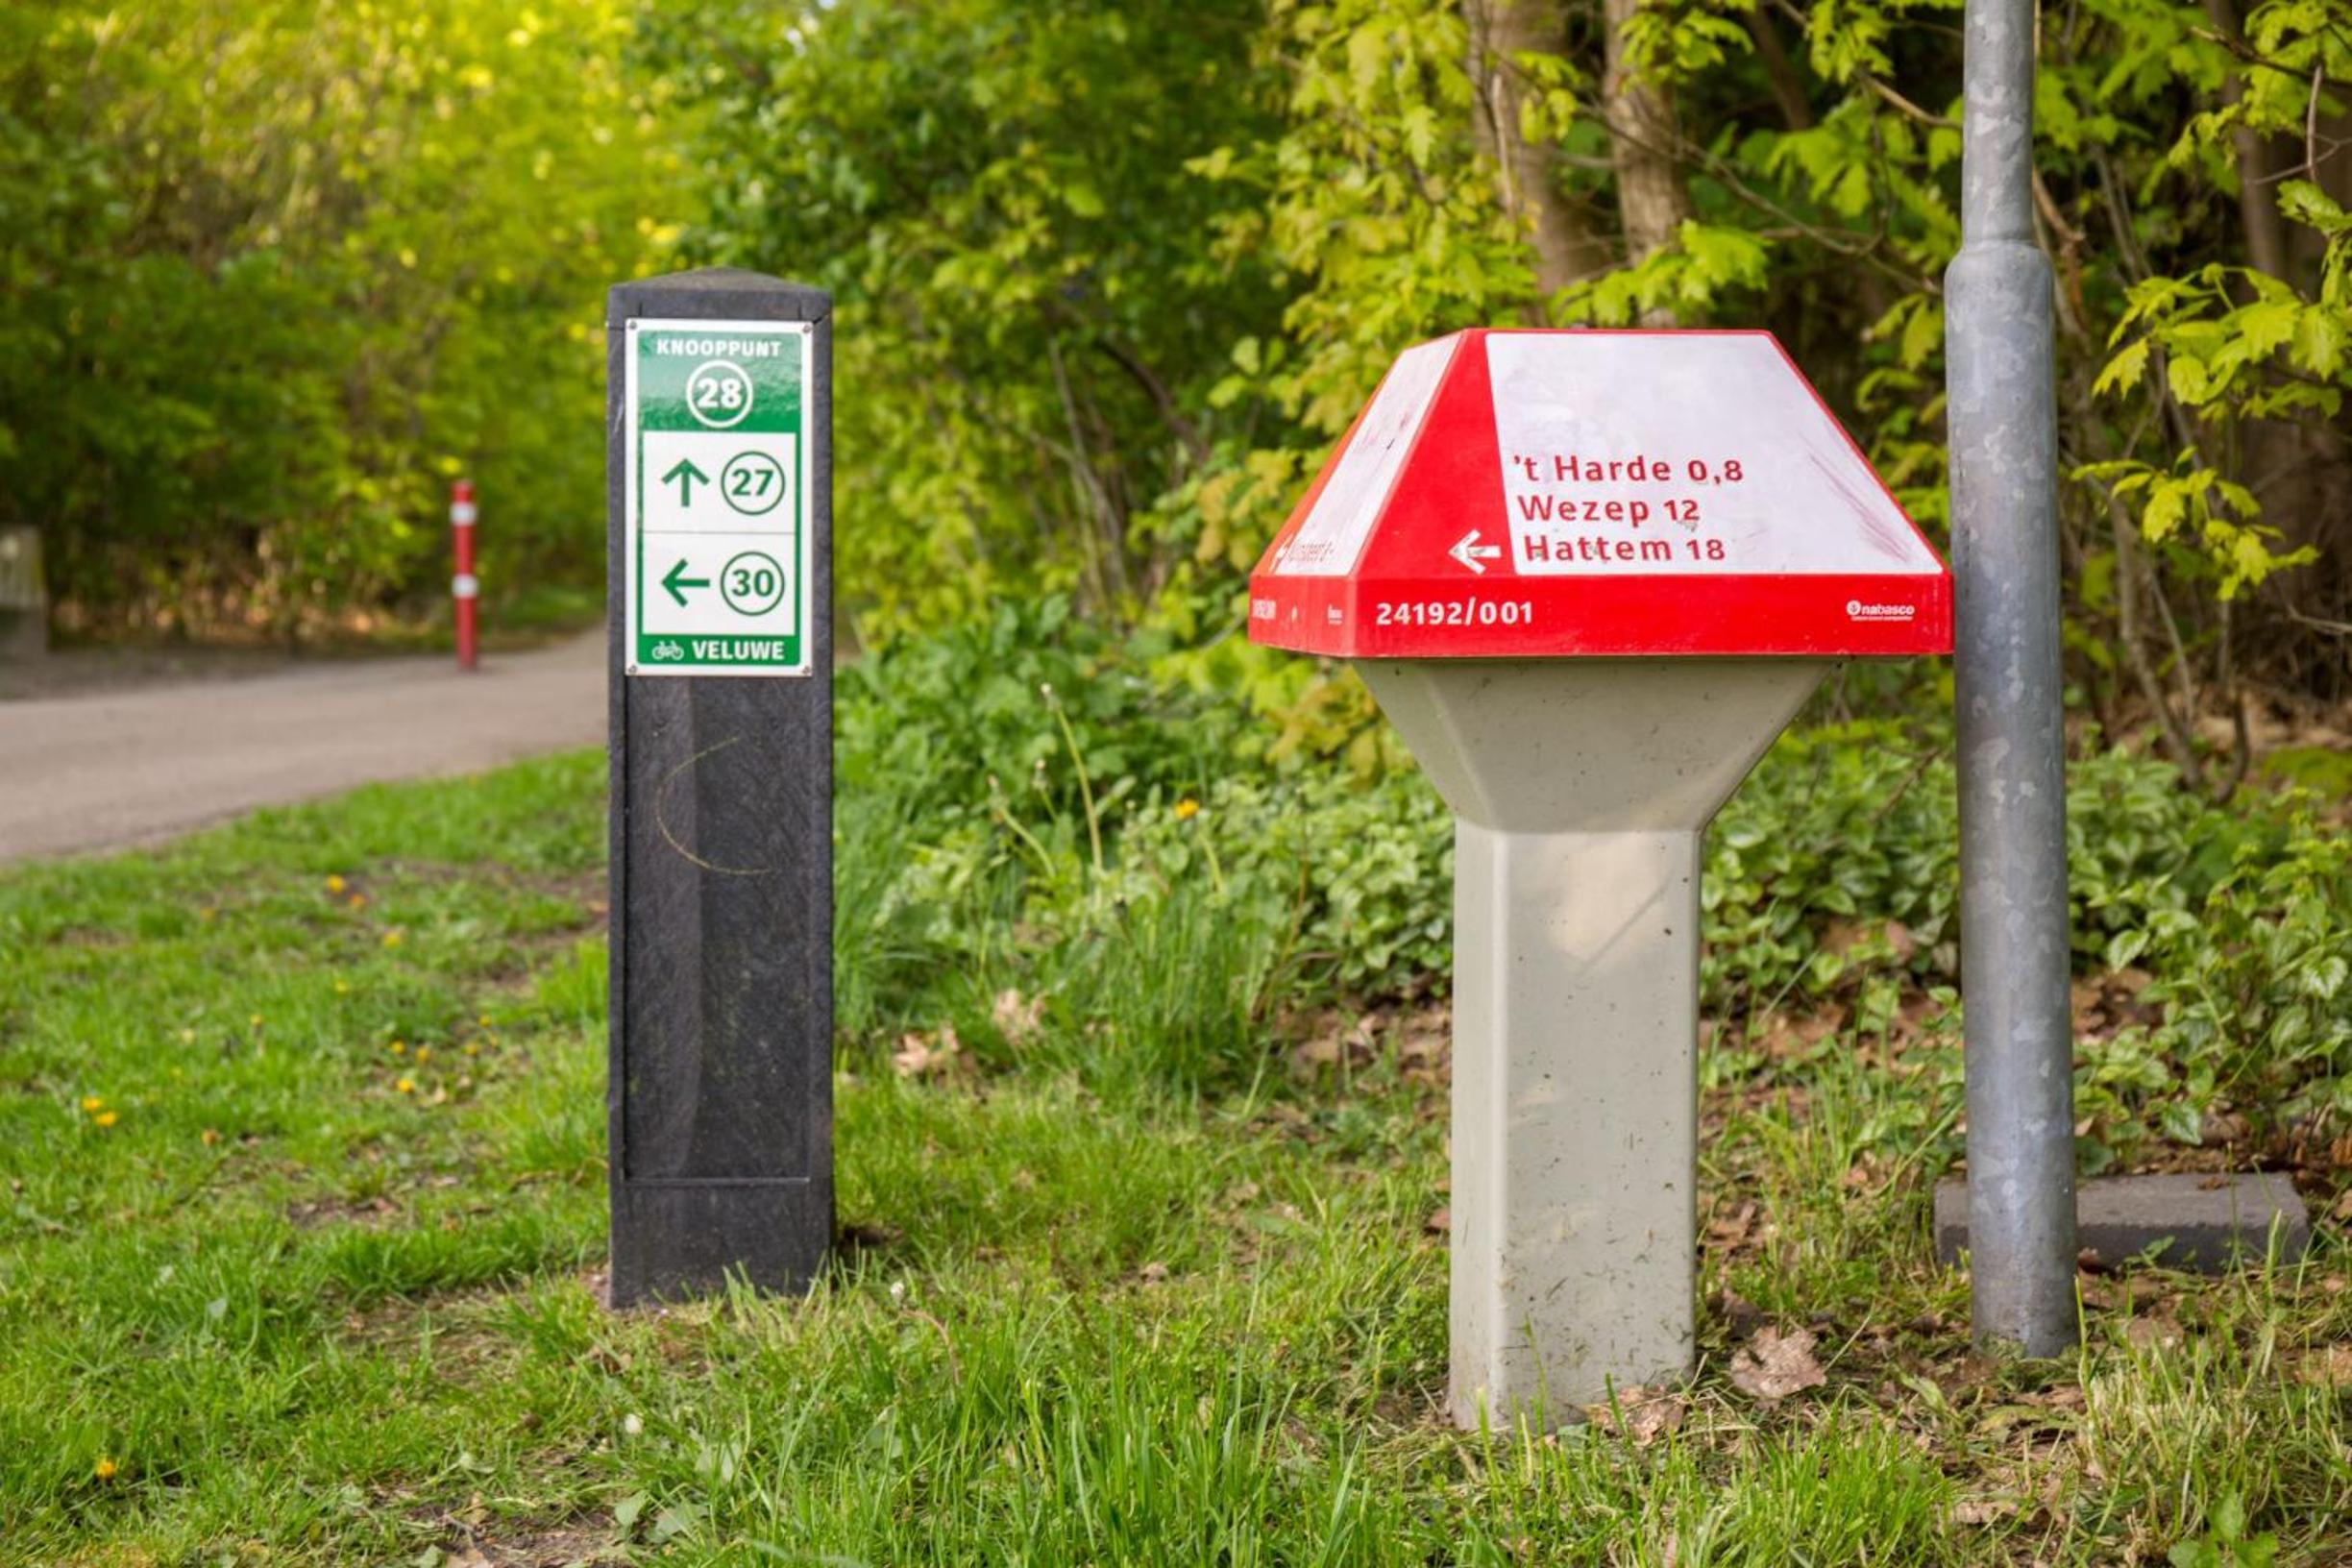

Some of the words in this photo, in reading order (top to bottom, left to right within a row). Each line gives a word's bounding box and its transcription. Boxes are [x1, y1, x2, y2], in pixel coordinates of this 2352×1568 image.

[657, 338, 781, 357] KNOOPPUNT
[697, 378, 743, 409] 28
[731, 468, 774, 497] 27
[1514, 455, 1539, 481] 't
[1556, 455, 1672, 481] Harde
[1688, 459, 1745, 484] 0,8
[1517, 495, 1651, 527] Wezep
[1663, 500, 1701, 522] 12
[1524, 535, 1672, 562] Hattem
[1686, 539, 1727, 561] 18
[731, 569, 774, 598] 30
[1376, 597, 1533, 626] 24192/001
[1861, 603, 1915, 616] nabasco
[692, 641, 785, 660] VELUWE
